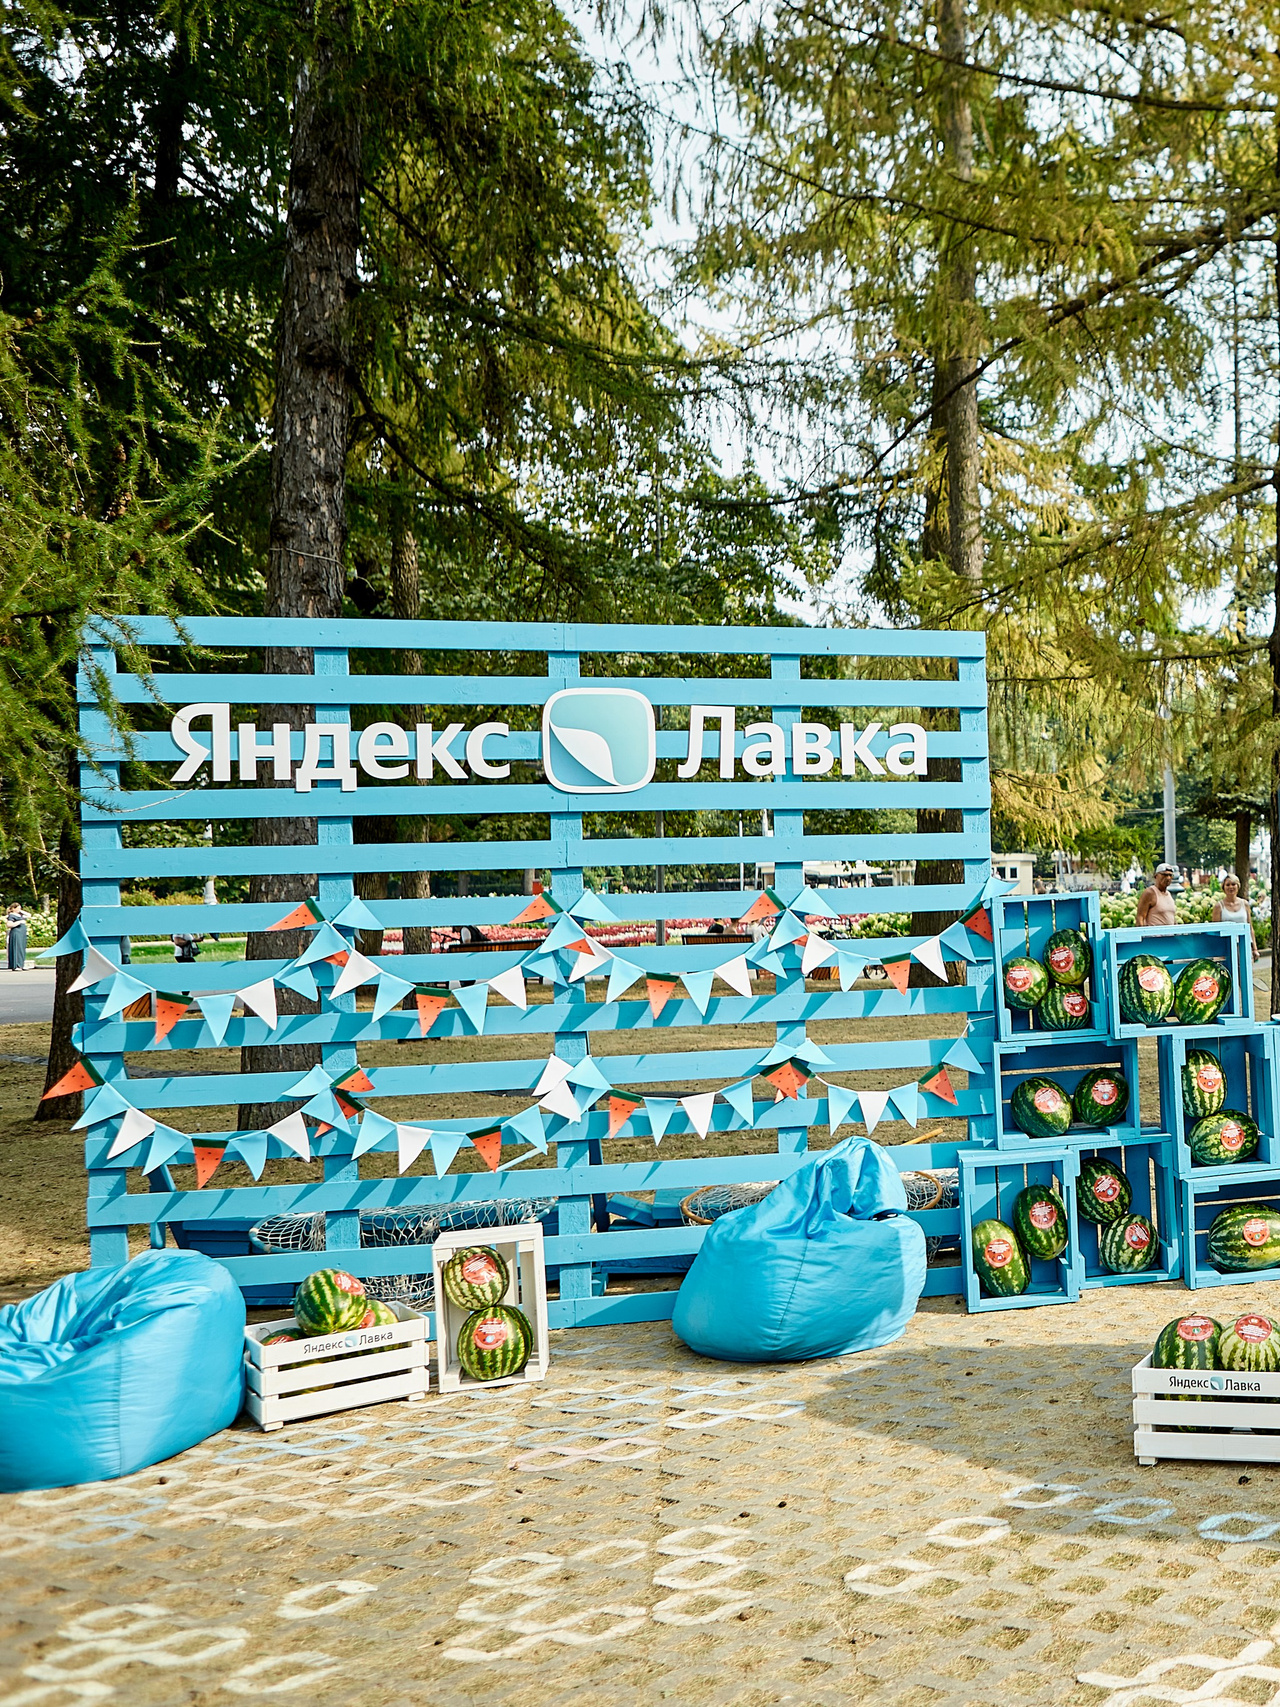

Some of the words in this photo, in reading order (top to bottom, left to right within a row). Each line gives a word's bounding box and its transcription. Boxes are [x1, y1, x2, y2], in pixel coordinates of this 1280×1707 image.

[170, 702, 512, 793] Яндекс
[676, 704, 929, 779] Лавка
[303, 1339, 344, 1355] Яндекс
[358, 1331, 394, 1346] Лавка
[1168, 1375, 1209, 1389] Яндекс
[1224, 1378, 1261, 1392] Лавка
